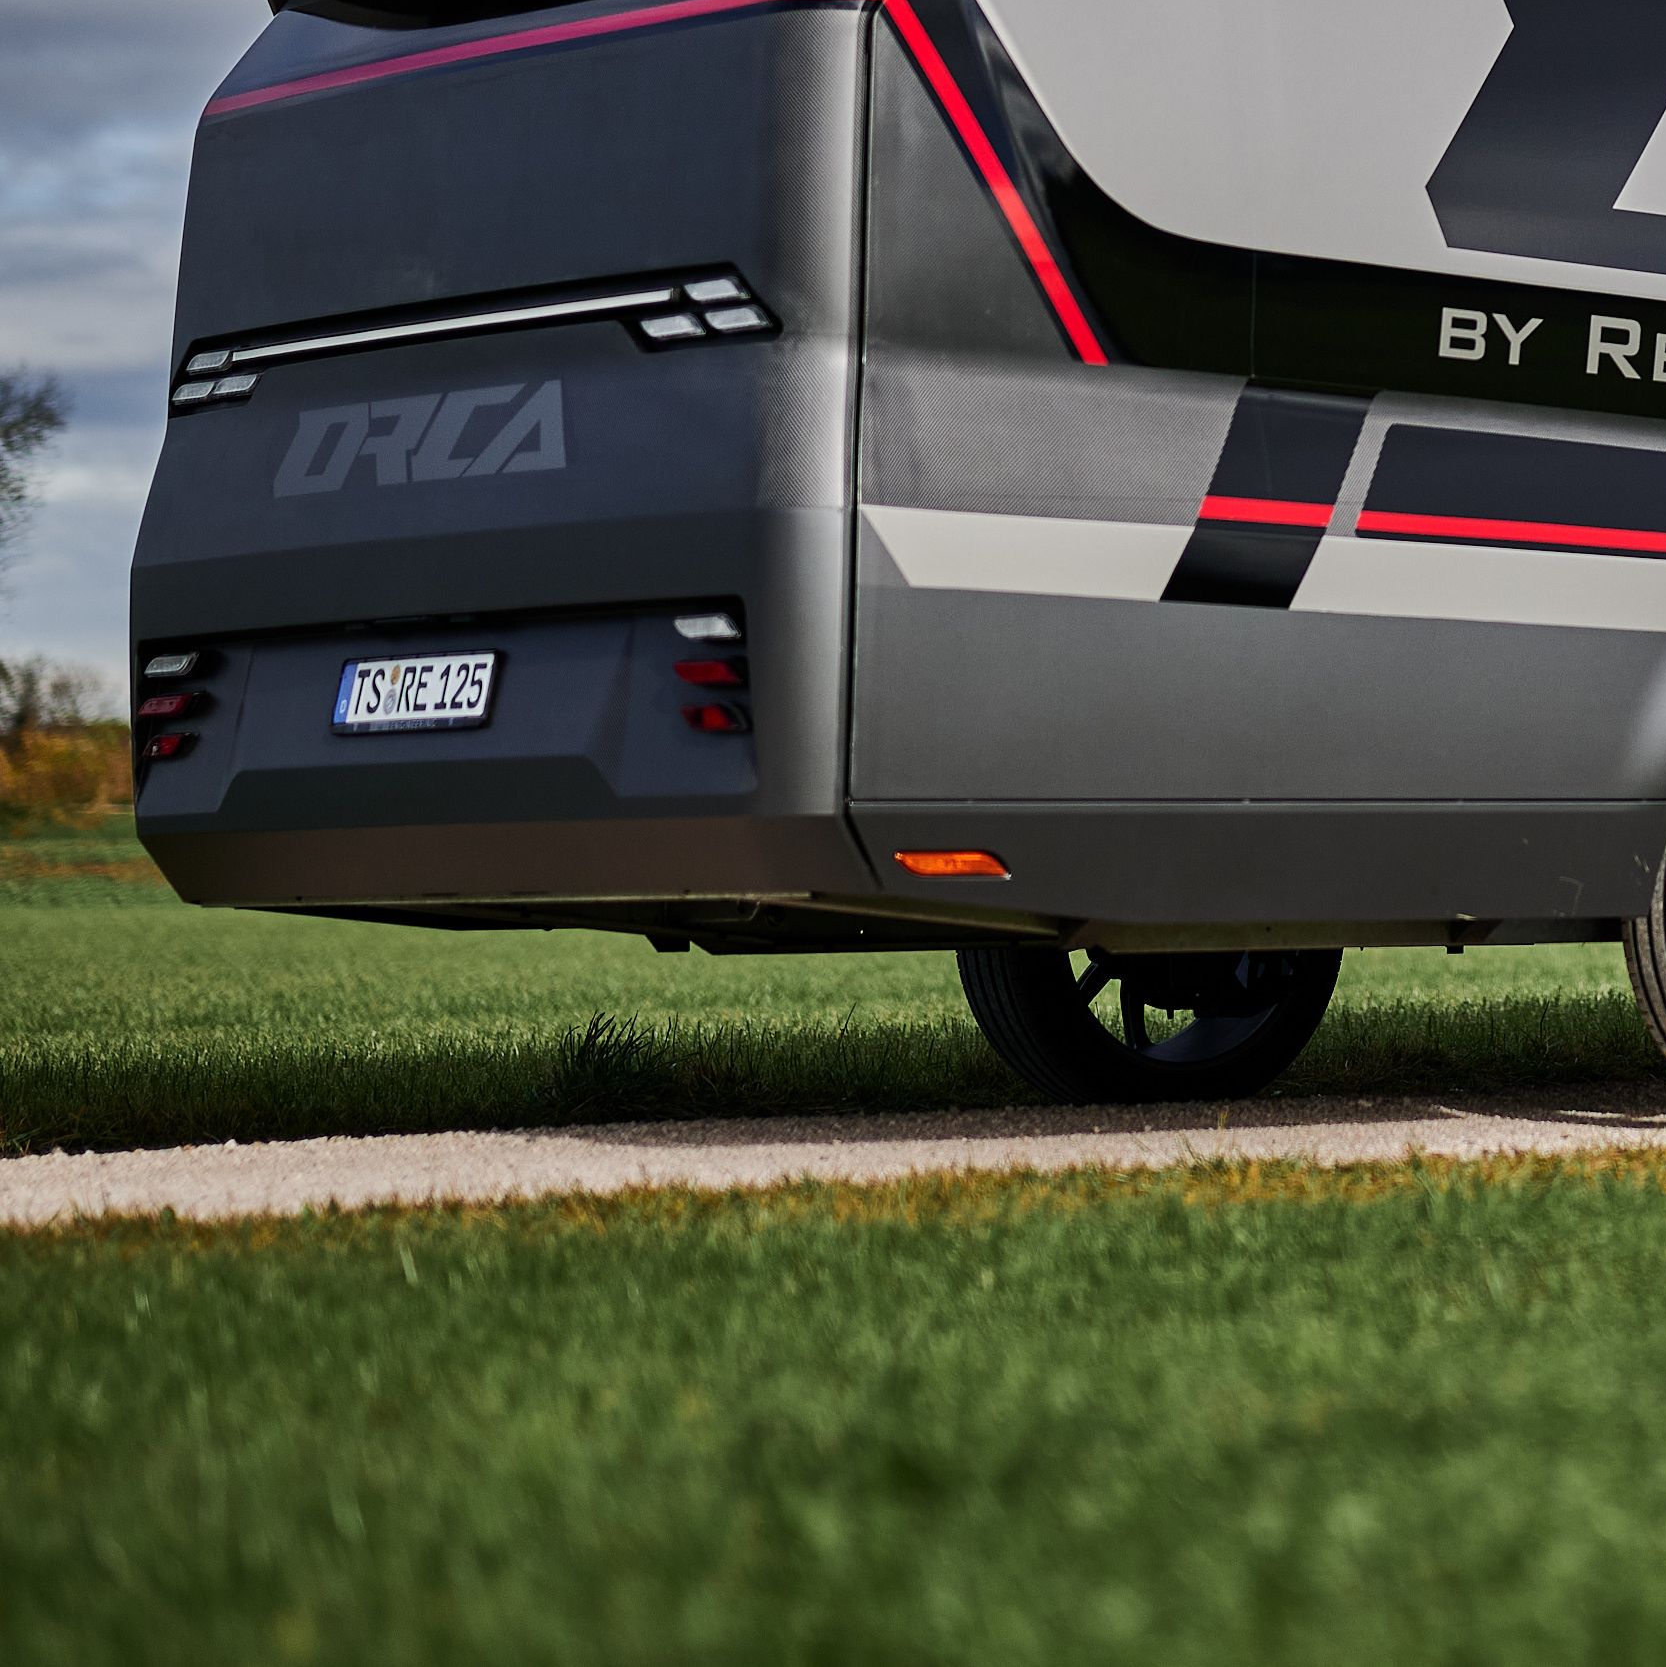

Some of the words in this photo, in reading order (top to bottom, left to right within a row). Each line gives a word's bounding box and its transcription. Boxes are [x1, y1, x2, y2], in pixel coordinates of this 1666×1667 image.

[1438, 306, 1544, 366] BY
[272, 379, 566, 499] ORCA
[354, 668, 386, 715] TS
[396, 665, 434, 713] RE
[434, 662, 487, 710] 125
